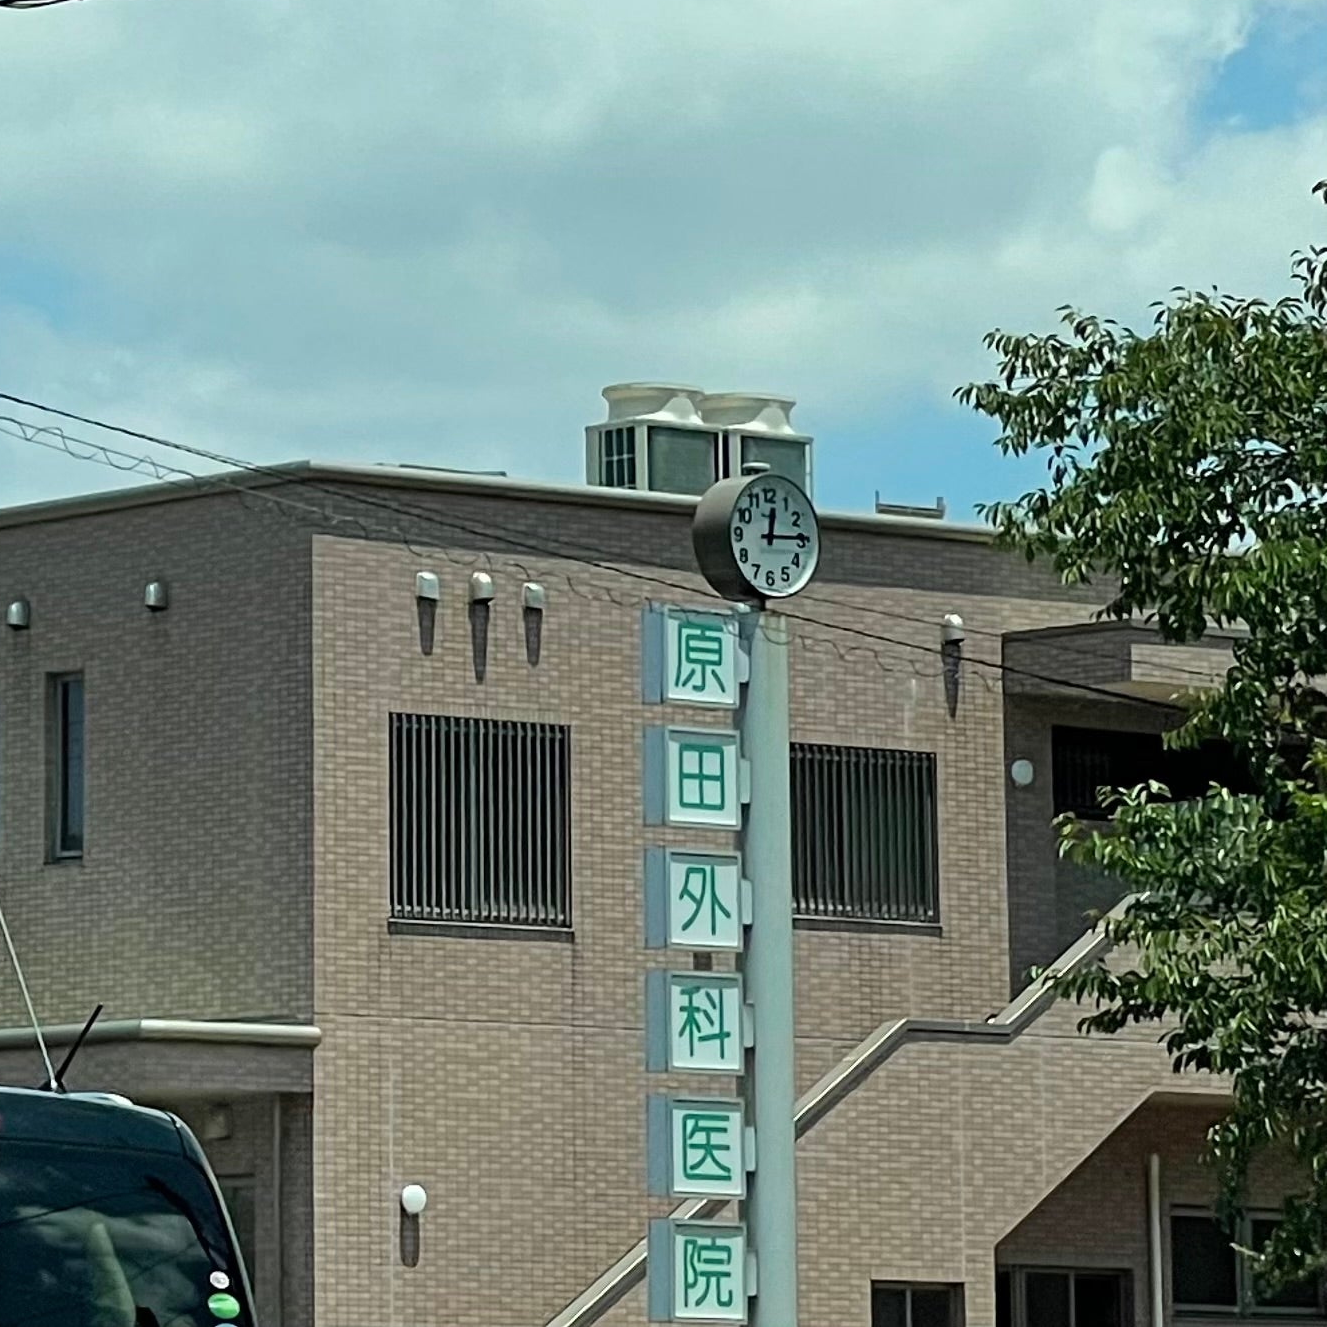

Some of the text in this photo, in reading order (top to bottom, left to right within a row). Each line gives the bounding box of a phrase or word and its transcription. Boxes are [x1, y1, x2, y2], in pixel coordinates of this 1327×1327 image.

[748, 492, 760, 509] 11
[762, 488, 776, 504] 12
[783, 497, 789, 512] 1
[737, 507, 752, 524] 10
[791, 511, 801, 528] 2
[734, 526, 743, 542] 9
[796, 532, 806, 548] 3
[739, 548, 748, 563] 8
[791, 553, 800, 568] 4
[751, 564, 761, 579] 7
[766, 570, 775, 586] 6
[781, 566, 790, 582] 5
[675, 622, 733, 1308] 原田外科医院
